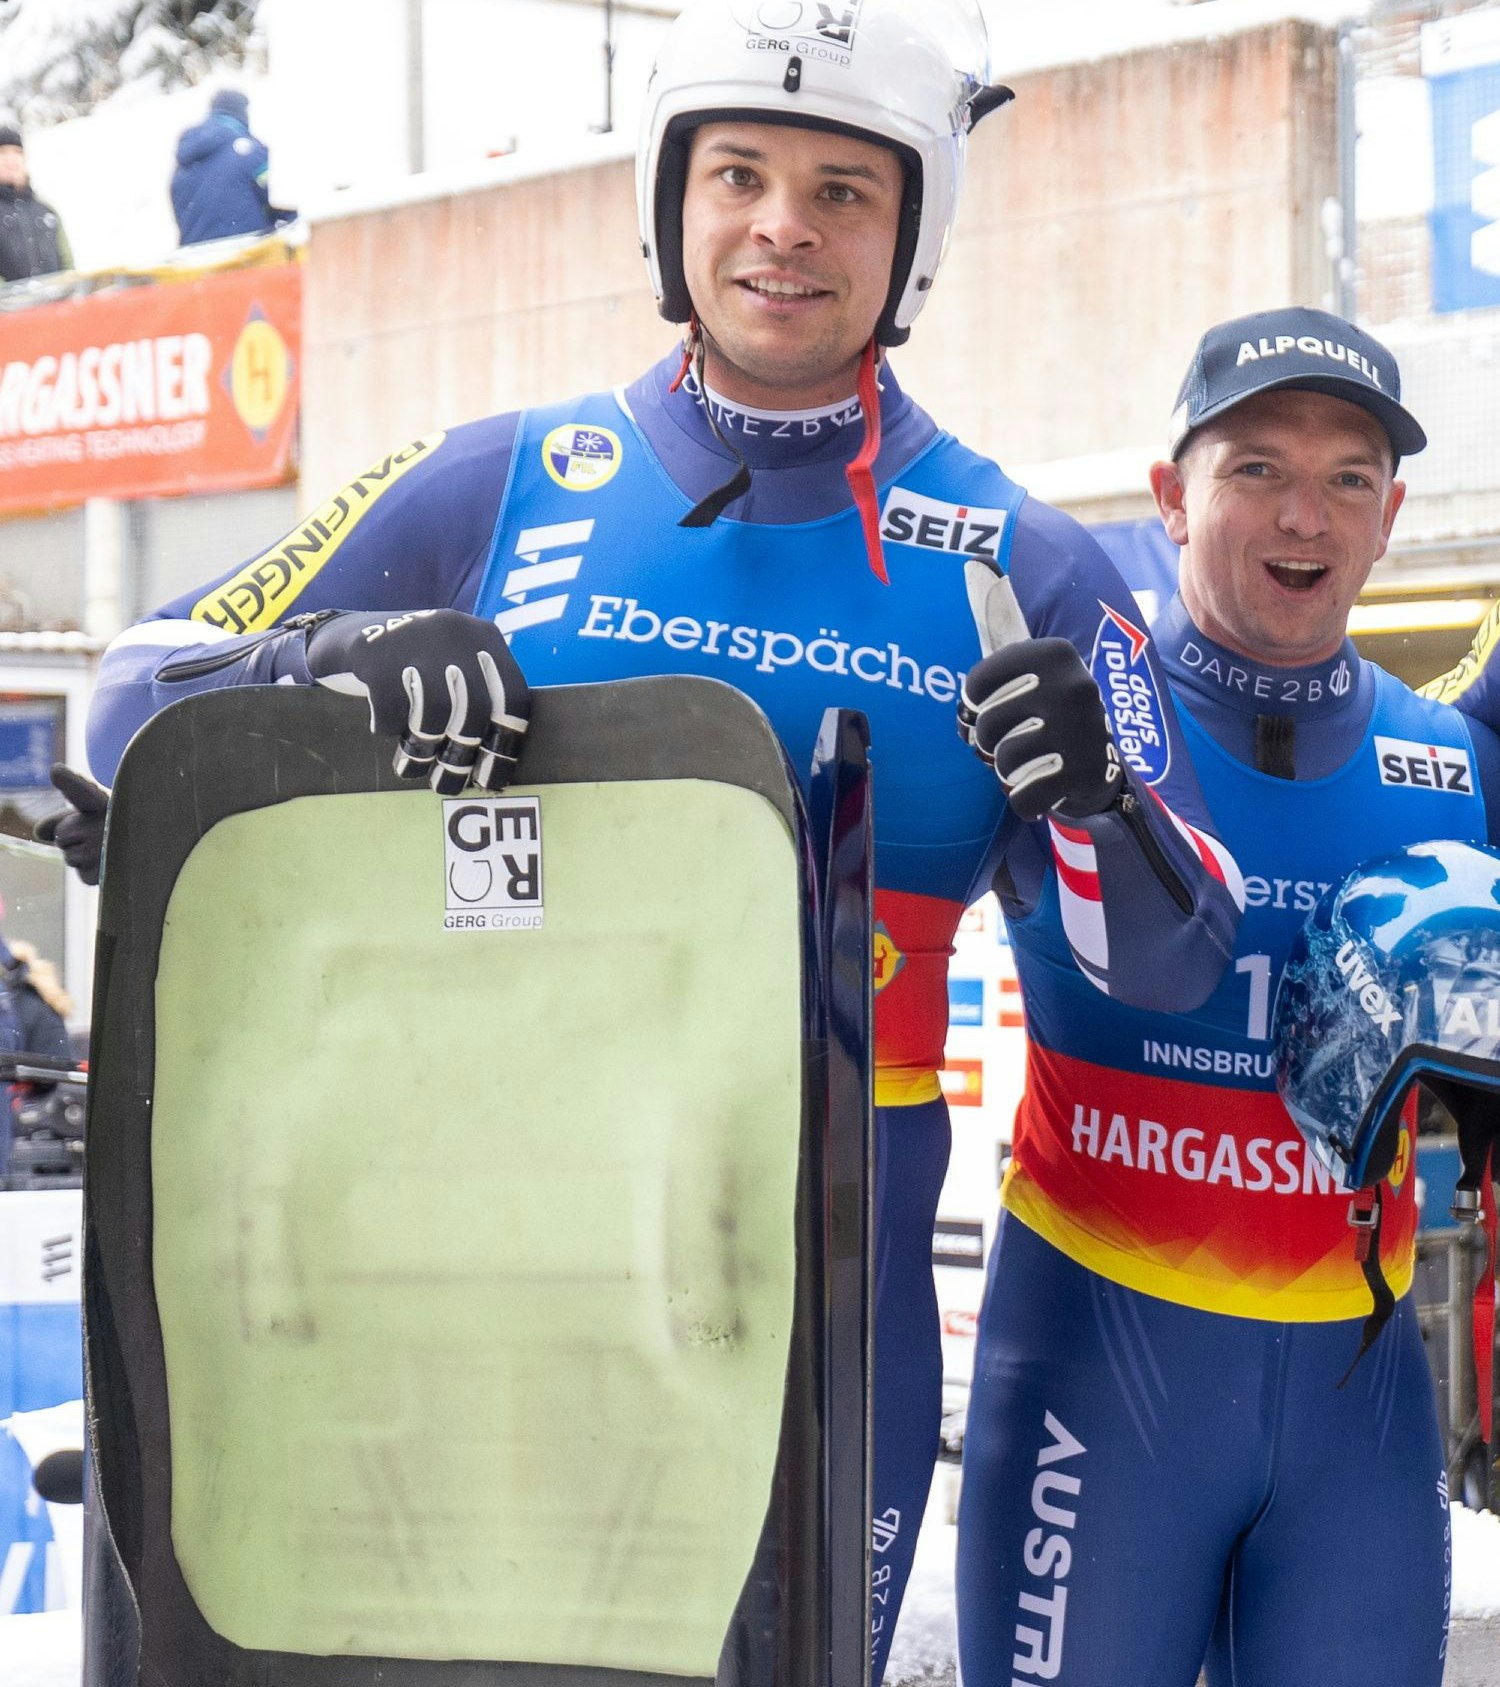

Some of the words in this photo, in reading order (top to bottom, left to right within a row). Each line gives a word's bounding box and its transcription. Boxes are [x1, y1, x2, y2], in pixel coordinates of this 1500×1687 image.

[746, 38, 790, 51] GERG
[796, 42, 850, 67] Group
[0, 332, 212, 435] RGASSNER
[1235, 335, 1382, 389] ALPQUELL
[1100, 640, 1154, 773] personal
[1128, 673, 1160, 748] shop
[444, 915, 486, 928] GERG
[491, 914, 542, 931] Group
[1334, 938, 1404, 1037] uvex
[1141, 1038, 1274, 1079] INNSBRU
[1070, 1102, 1357, 1197] HARGASSN
